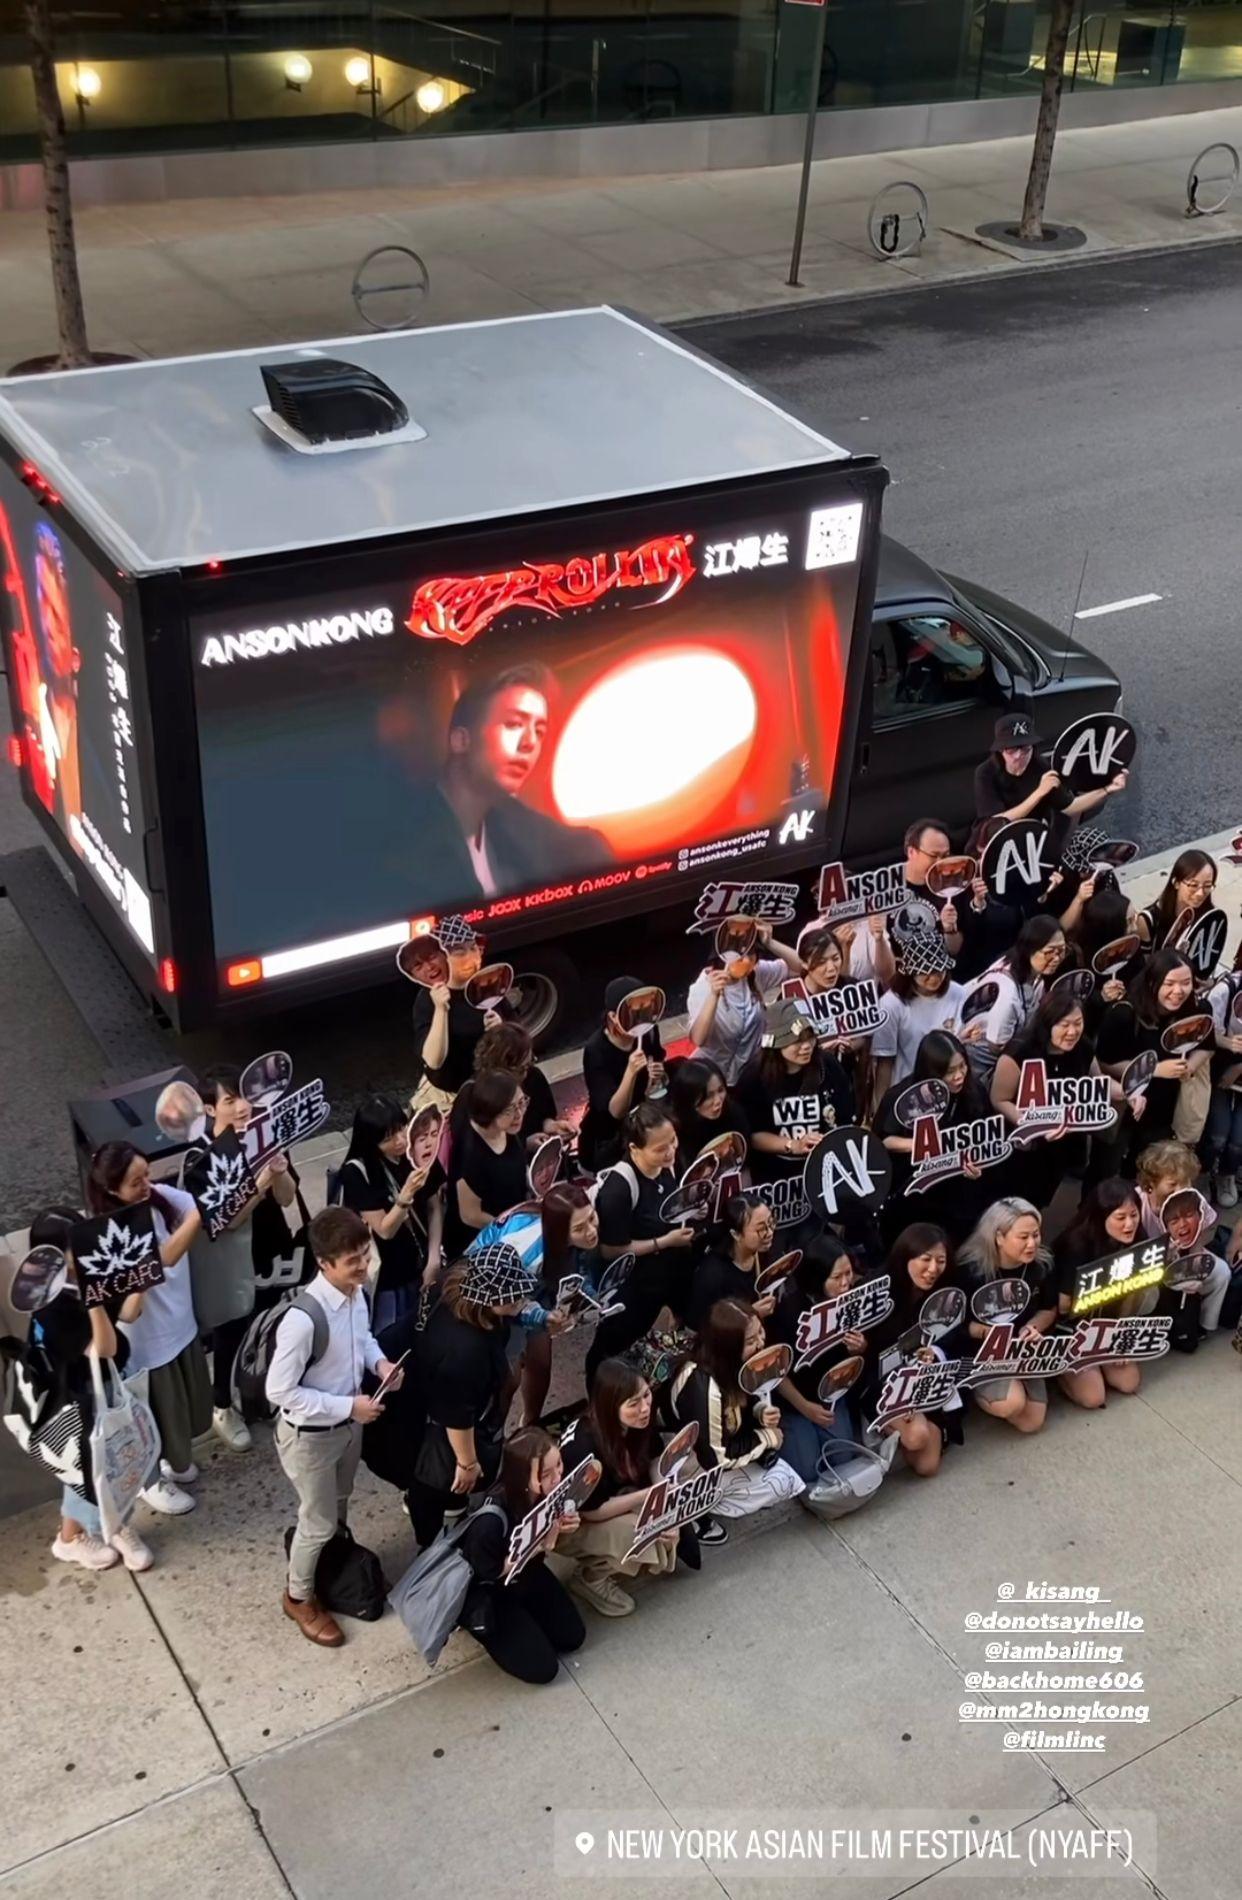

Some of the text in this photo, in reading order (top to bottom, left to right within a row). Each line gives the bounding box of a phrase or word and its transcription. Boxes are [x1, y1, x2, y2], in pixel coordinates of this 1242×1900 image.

[1061, 726, 1129, 776] AK
[778, 809, 816, 845] AK
[990, 830, 1055, 895] AK
[820, 862, 904, 909] ANSON
[865, 888, 904, 914] KONG
[1188, 919, 1224, 970] AK
[835, 1006, 881, 1033] KONG
[1018, 1061, 1109, 1109] ANSON
[774, 1098, 818, 1124] WE
[1064, 1104, 1107, 1124] KONG
[913, 1116, 1004, 1164] ANSON
[961, 1140, 1003, 1168] KONG
[818, 1134, 886, 1214] AK
[209, 1208, 229, 1238] AK
[772, 1201, 804, 1221] ONG
[85, 1260, 161, 1306] AK CAFC
[975, 1325, 1072, 1364] ANSON
[1017, 1358, 1061, 1373] KONG
[637, 1467, 721, 1530] ANSON
[676, 1488, 716, 1521] KONG
